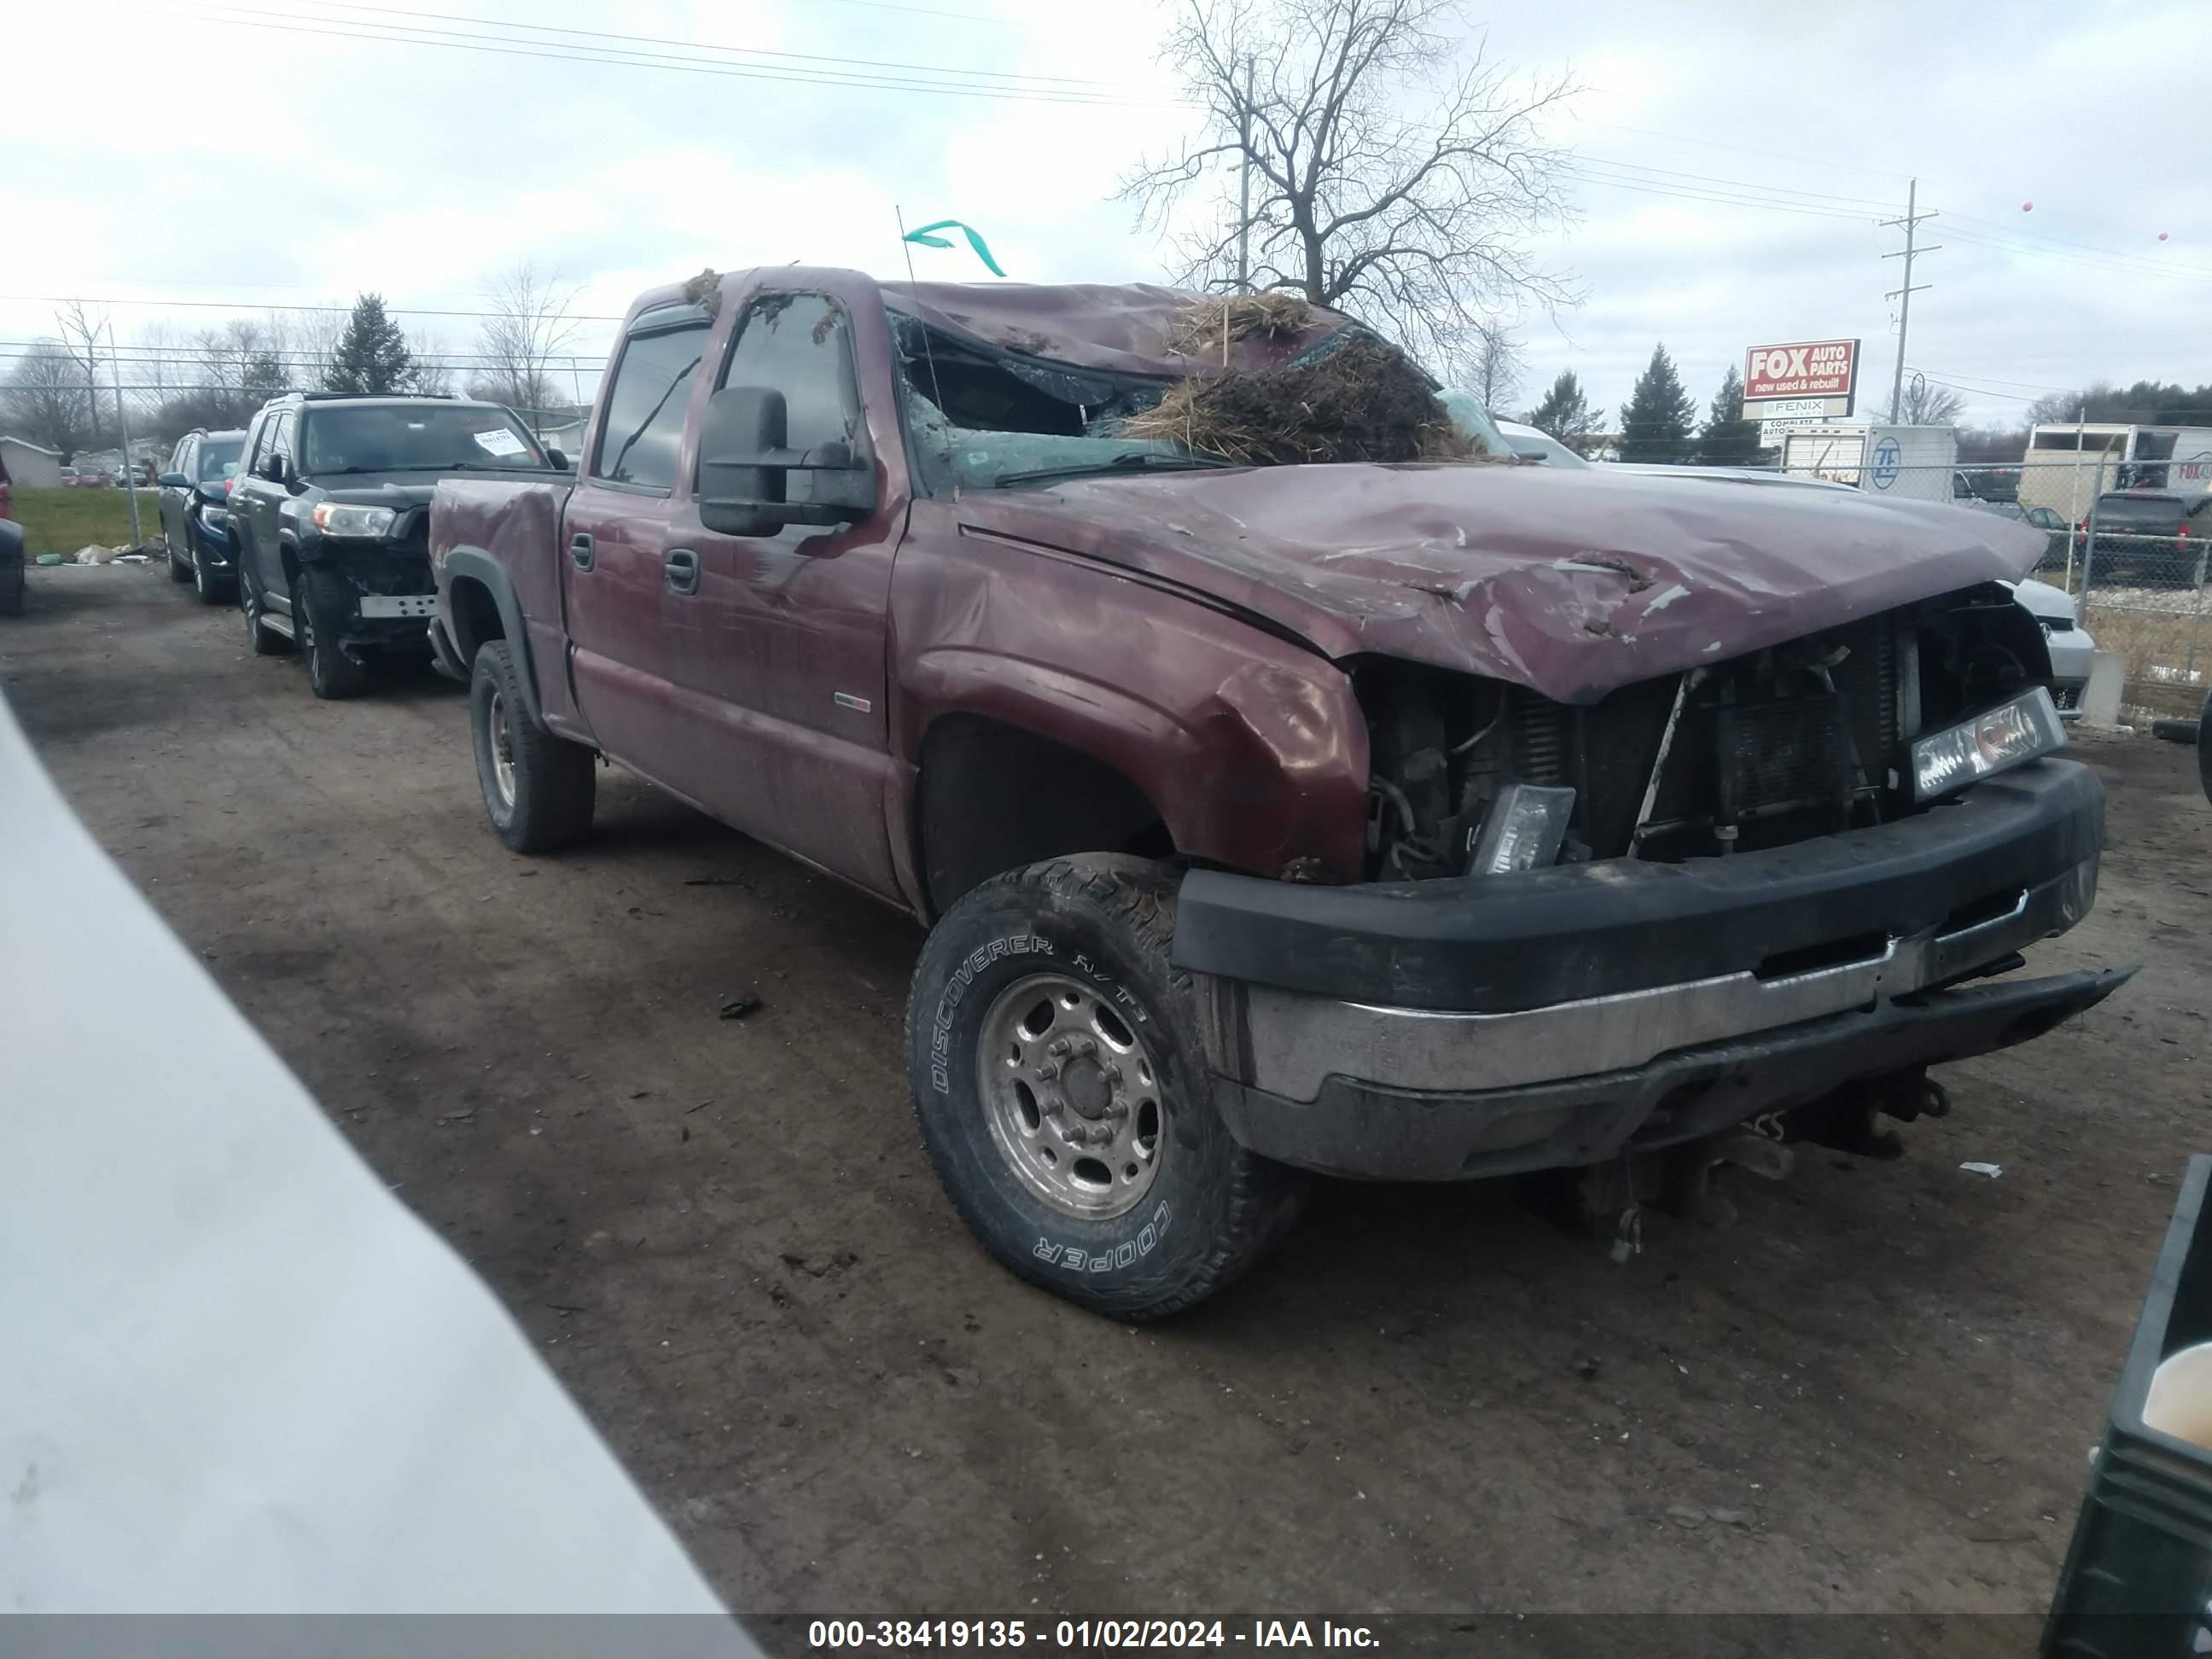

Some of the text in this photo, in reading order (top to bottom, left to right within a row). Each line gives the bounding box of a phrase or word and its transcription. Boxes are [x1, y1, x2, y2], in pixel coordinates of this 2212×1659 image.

[1811, 346, 1846, 362] AUTO
[1750, 348, 1809, 380] FOX
[1810, 360, 1848, 376] PARTS
[1755, 377, 1840, 393] new used & rebuilt
[1776, 400, 1823, 411] FENIX
[931, 934, 1054, 1094] DISCOVERER
[1033, 1199, 1173, 1272] COOPER
